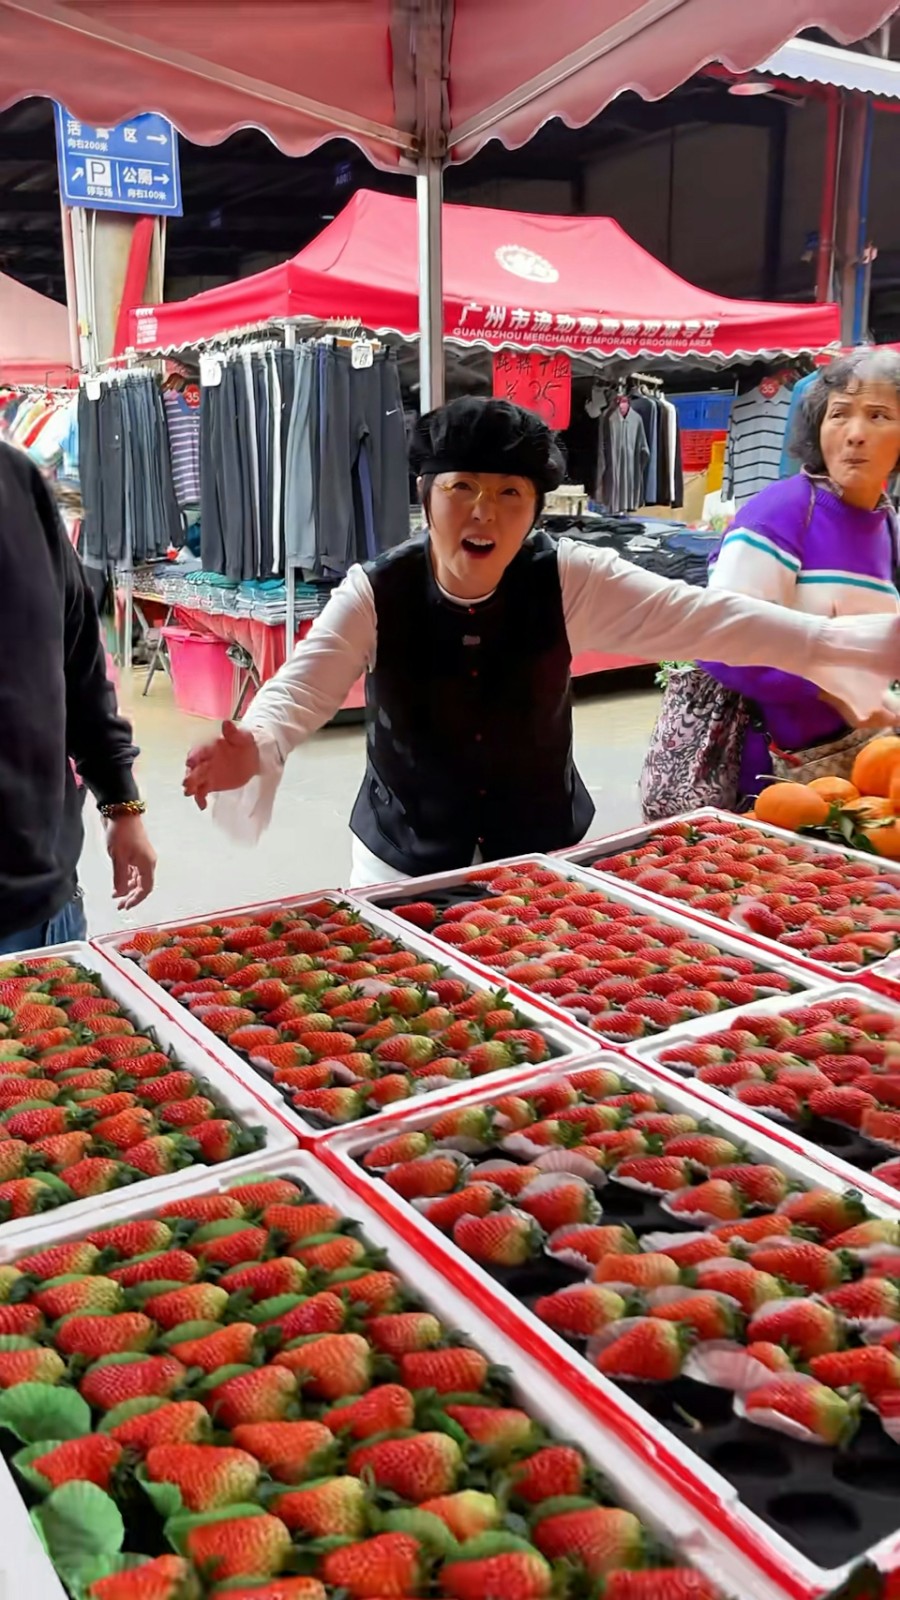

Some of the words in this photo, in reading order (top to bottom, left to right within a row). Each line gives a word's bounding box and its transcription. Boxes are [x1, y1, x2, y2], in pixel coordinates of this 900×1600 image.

[67, 138, 108, 152] 向右200米
[90, 161, 106, 183] P
[86, 186, 114, 198] 停车场
[127, 188, 167, 200] 向右100米
[453, 327, 521, 341] GUANGZHOU
[522, 332, 578, 344] MERCHANT
[580, 335, 639, 346] TEMPORARY
[639, 338, 688, 347] GROOMING
[688, 338, 712, 347] AREA
[762, 383, 775, 394] 35
[186, 392, 200, 402] 35
